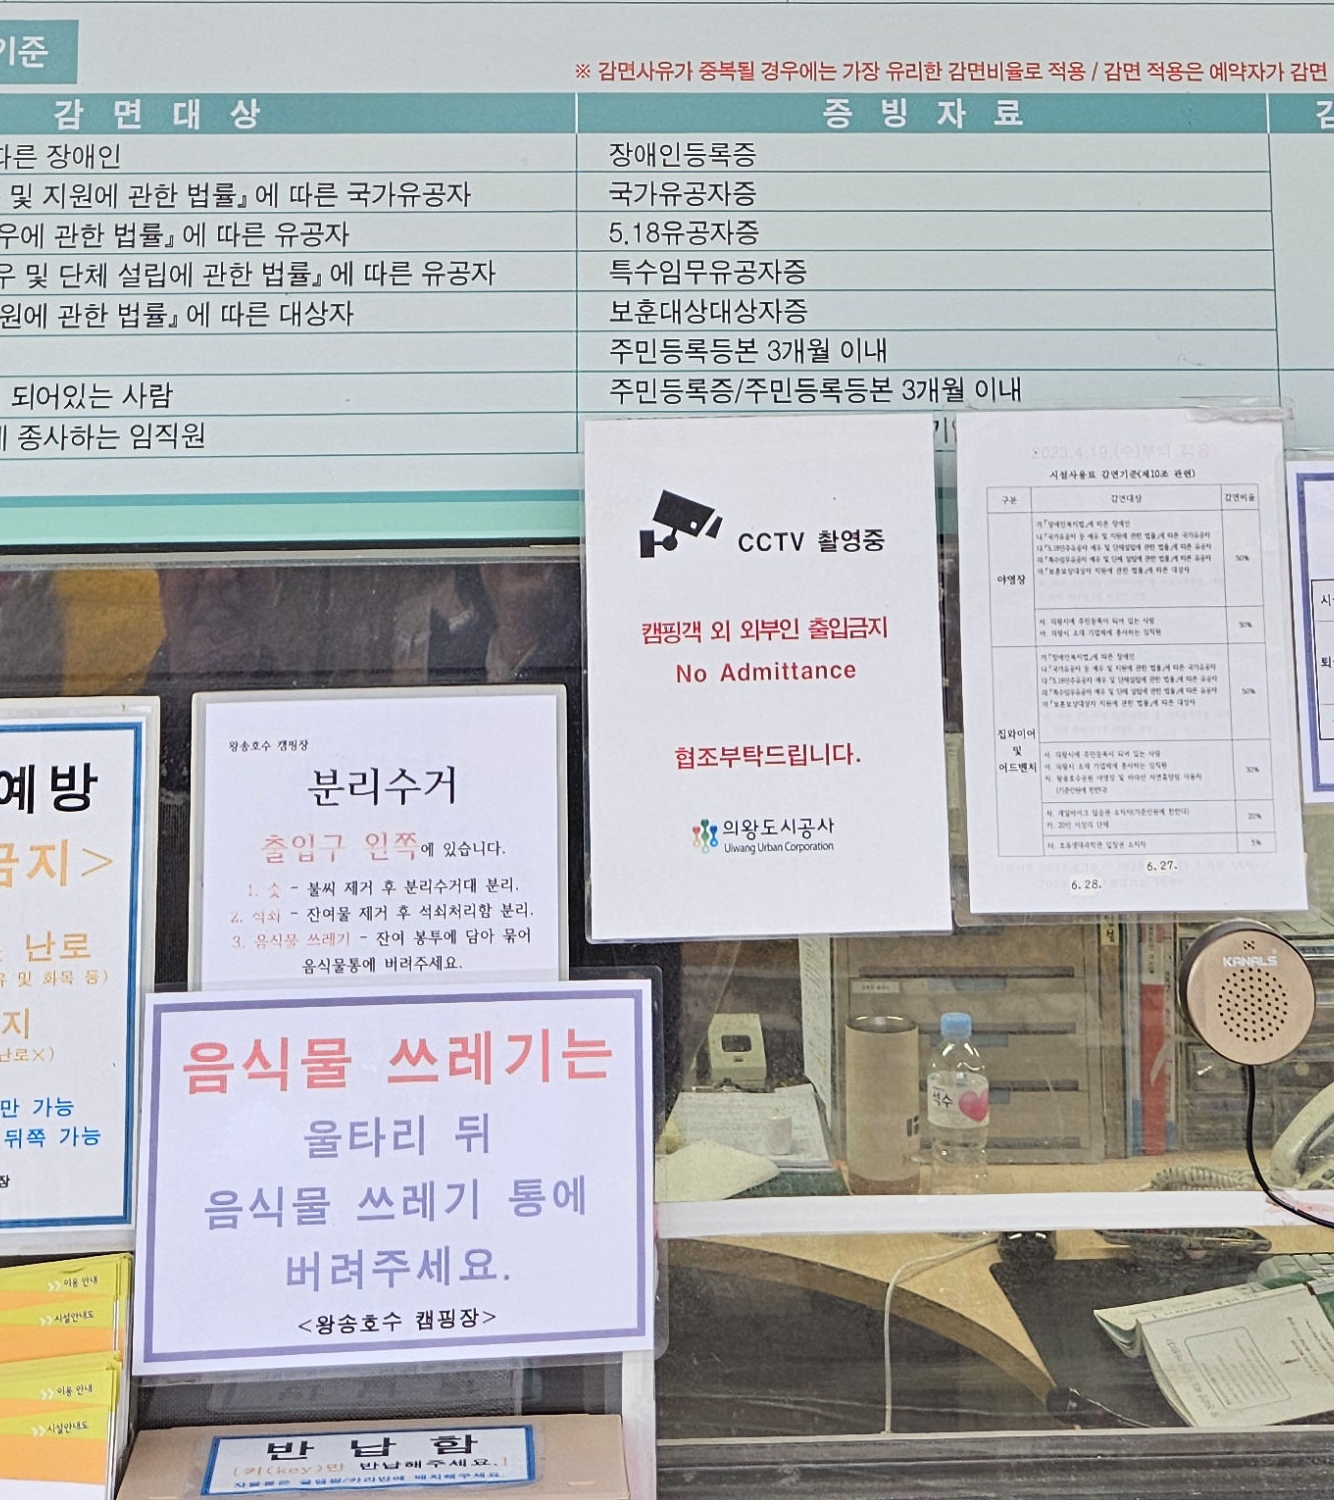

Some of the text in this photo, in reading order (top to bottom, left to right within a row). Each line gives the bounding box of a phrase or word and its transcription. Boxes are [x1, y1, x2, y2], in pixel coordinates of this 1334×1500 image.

[599, 61, 693, 81] 감면사유가
[47, 144, 119, 169] 장애인
[610, 142, 756, 167] 장애인등록증
[347, 181, 471, 207] 국가유공자
[609, 181, 756, 206] 국가유공자증
[610, 220, 759, 245] 5.18유공자증
[610, 259, 806, 285] 특수임무유공자증
[610, 298, 807, 325] 보훈대상대상자증
[610, 338, 886, 365] 주민등록등본 이내
[610, 377, 893, 404] 주민등록증/주민등록등본
[18, 424, 120, 450] 종사하는
[131, 423, 204, 449] 임직원
[739, 529, 885, 552] CCTV 촬영중
[642, 616, 887, 644] 캠핑객 외부인 출입금지
[677, 662, 855, 683] No Admittance
[675, 743, 860, 769] 협조부탁드립니다.
[308, 766, 454, 806] 분리수거
[723, 818, 834, 840] 의왕도시공사
[444, 841, 505, 857] 있습니다.
[725, 842, 834, 855] Uiwang Urban Corporation
[404, 878, 476, 894] 분리수거대
[420, 903, 492, 920] 석쇠처리함
[26, 931, 90, 962] 난로
[302, 956, 462, 974] 음식물통에 버려주세요.
[1223, 956, 1277, 967] KANALS
[183, 1029, 612, 1094] 음식물 쓰레기는
[33, 1097, 74, 1117] 가능
[4, 1128, 45, 1149] 뒤쪽
[304, 1113, 488, 1158] 울타리 뒤
[205, 1175, 585, 1230] 음식물 쓰레기 통에
[287, 1246, 509, 1291] 버려주세요.
